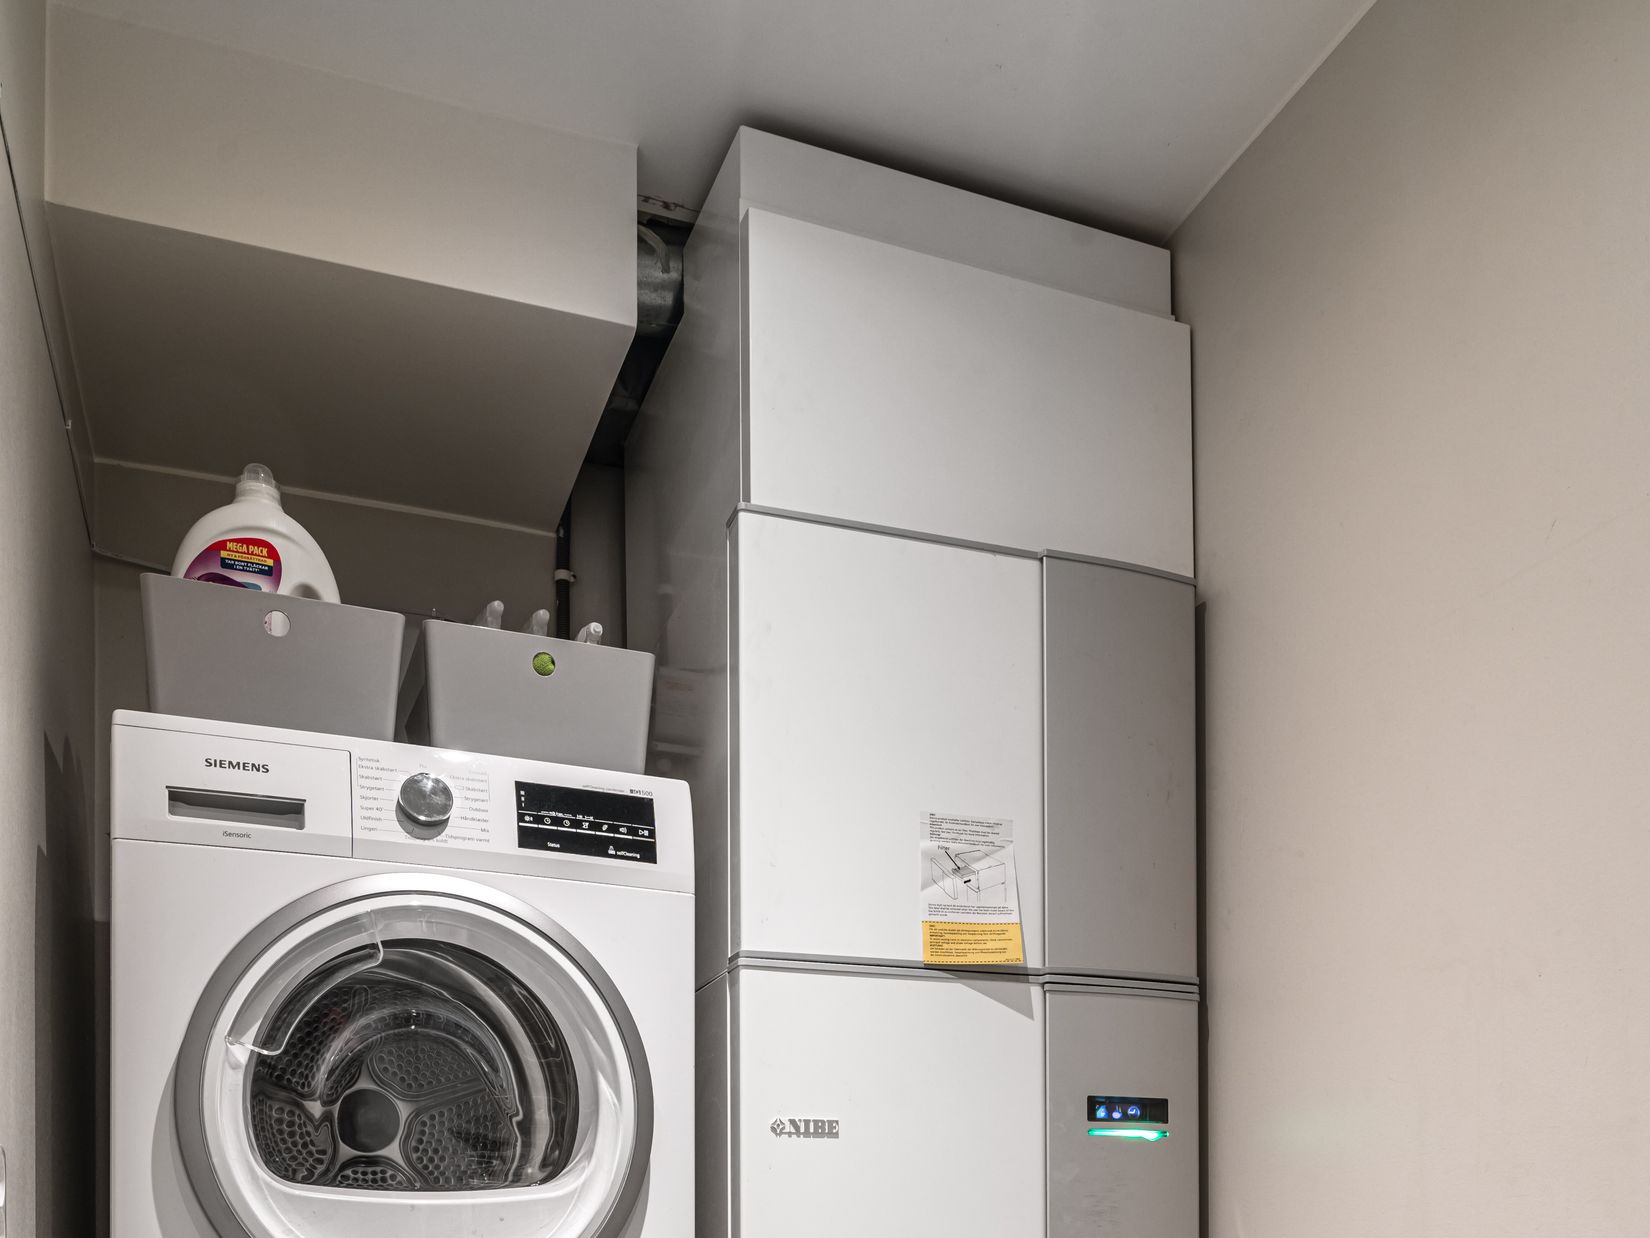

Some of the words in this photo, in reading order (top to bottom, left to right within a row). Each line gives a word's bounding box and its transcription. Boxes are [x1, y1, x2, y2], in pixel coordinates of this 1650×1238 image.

[227, 541, 247, 553] MEGA
[248, 545, 269, 557] PACK
[204, 757, 270, 774] SIEMENS
[222, 830, 252, 839] iSensoric
[788, 1118, 839, 1139] NIBE
